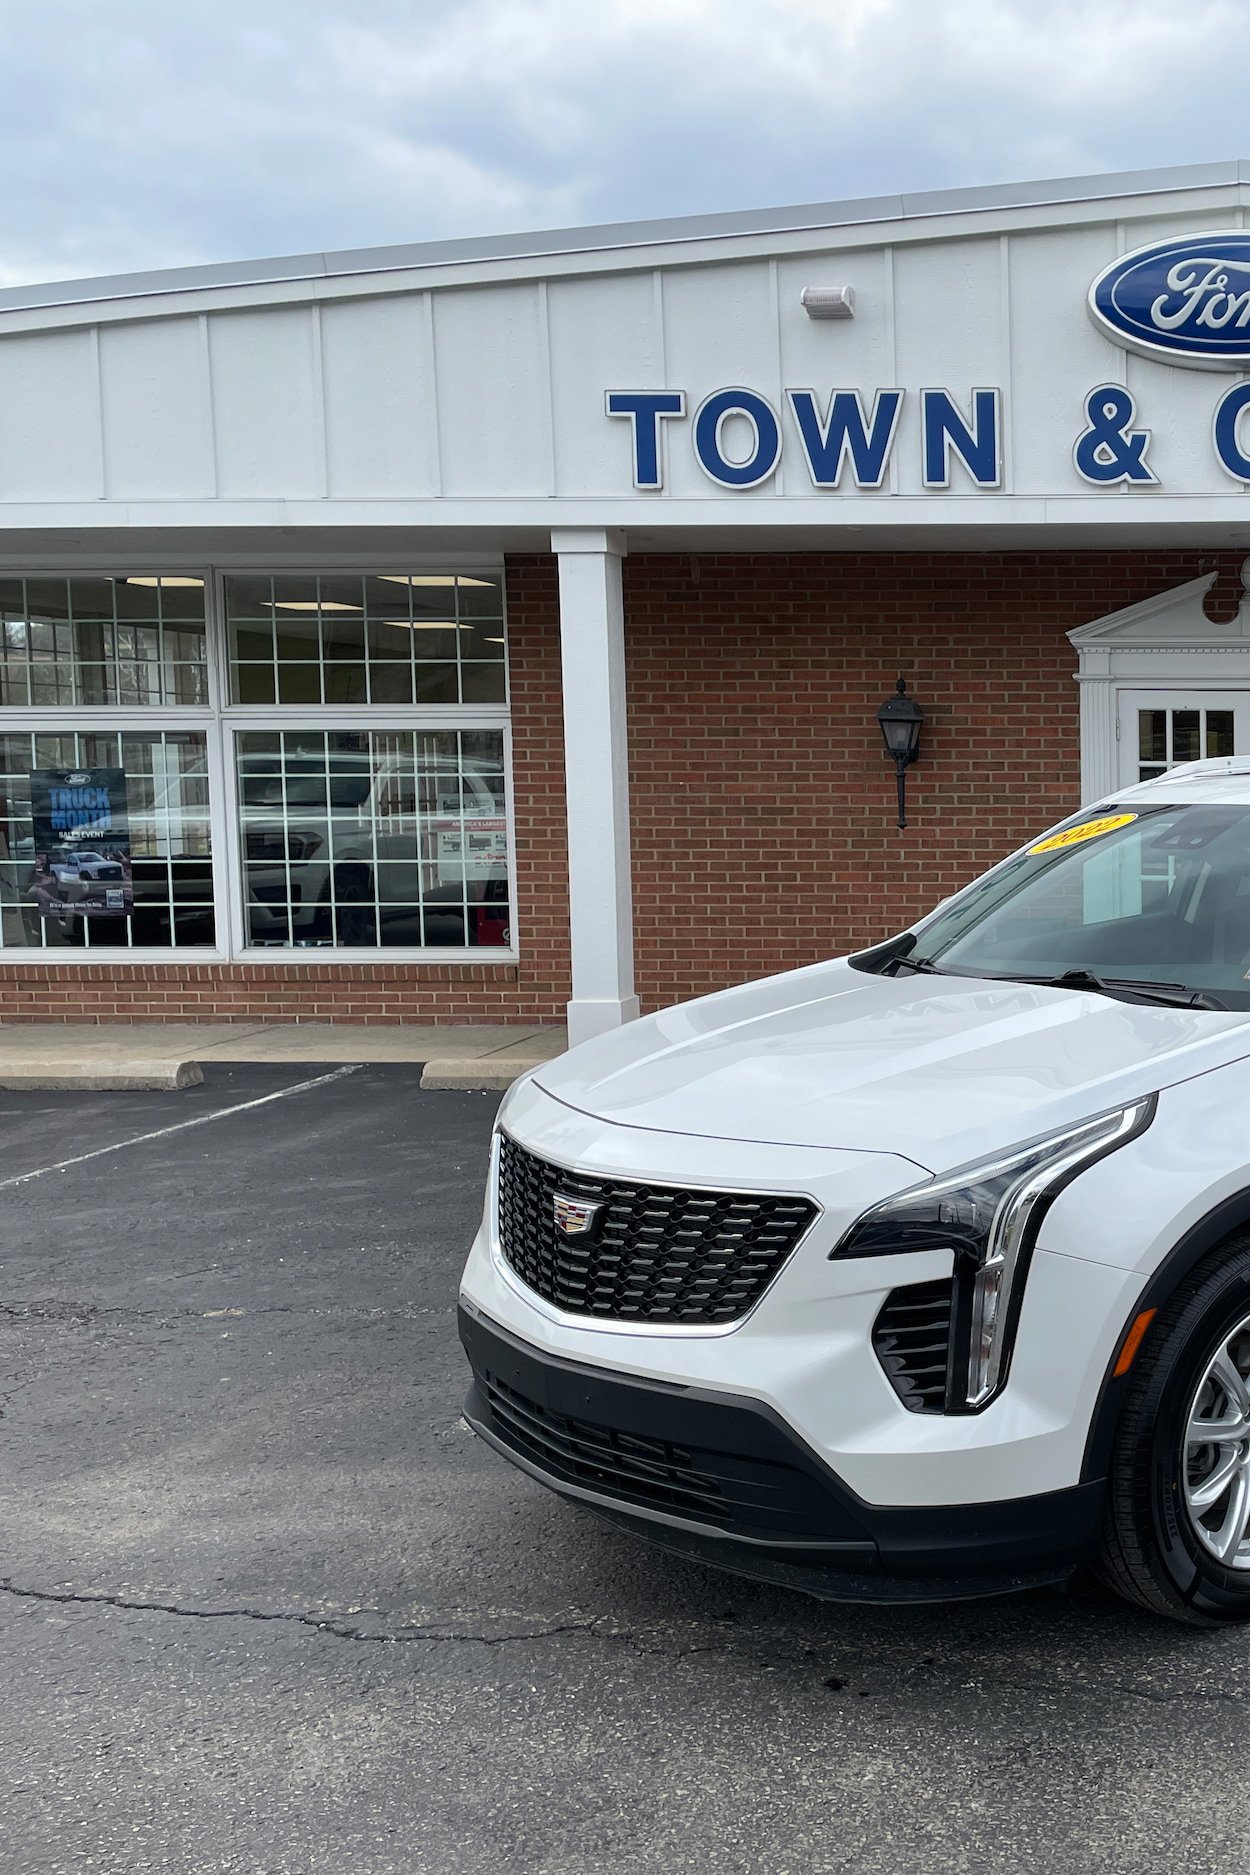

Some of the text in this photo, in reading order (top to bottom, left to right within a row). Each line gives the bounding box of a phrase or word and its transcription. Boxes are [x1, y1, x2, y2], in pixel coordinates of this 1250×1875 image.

[604, 386, 1002, 490] TOWN
[1072, 382, 1162, 486] &
[48, 787, 111, 809] TRUCK
[51, 809, 113, 830] MONTH
[58, 831, 81, 839] SALES
[1040, 817, 1121, 851] 2022
